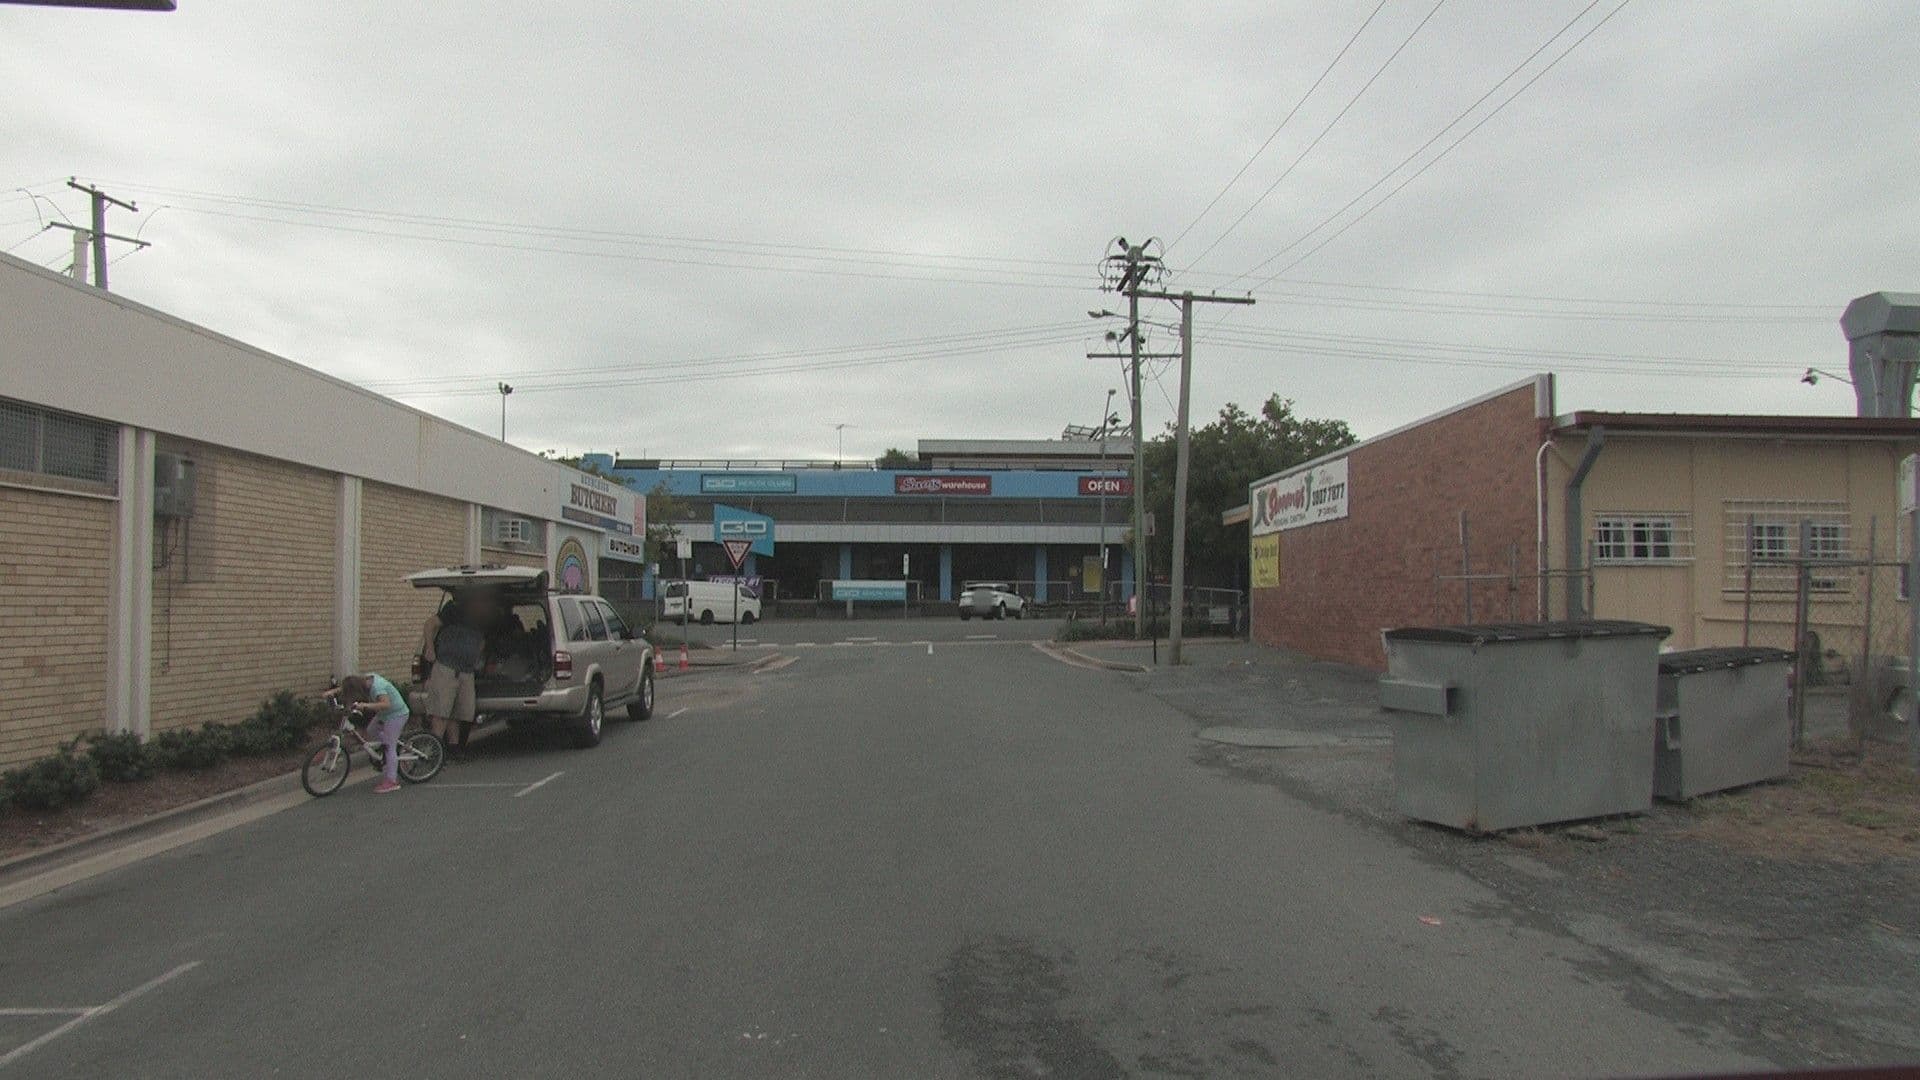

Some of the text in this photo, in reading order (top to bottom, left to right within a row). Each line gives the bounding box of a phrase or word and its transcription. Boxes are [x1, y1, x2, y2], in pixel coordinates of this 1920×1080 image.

[1087, 480, 1120, 491] OPEN
[570, 483, 617, 516] BUTCHERY
[720, 520, 767, 534] GO
[609, 539, 640, 556] BUTCHER
